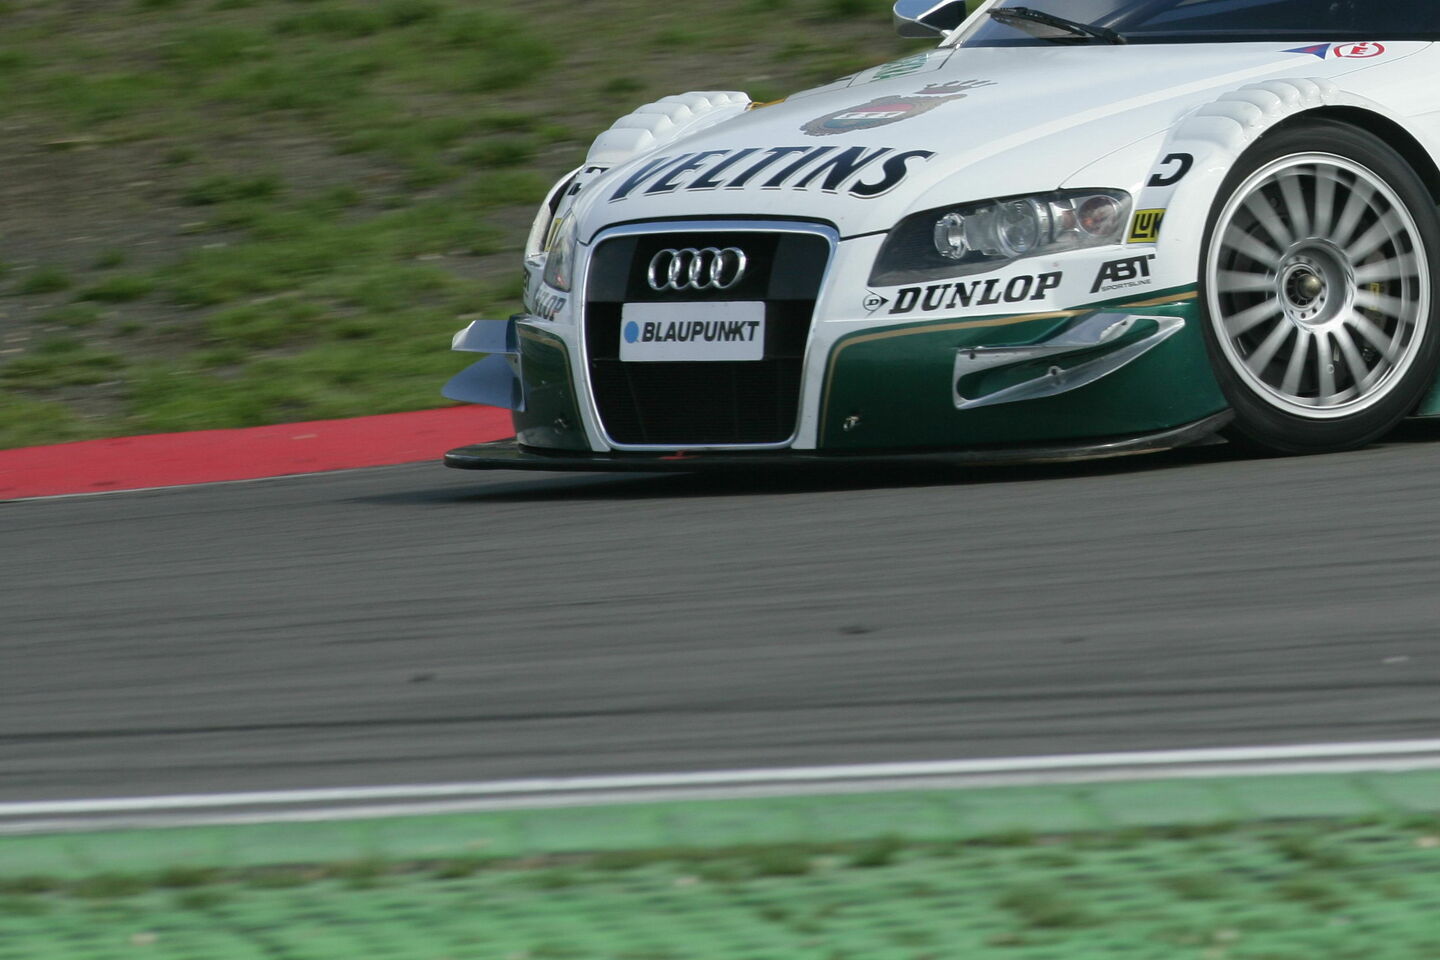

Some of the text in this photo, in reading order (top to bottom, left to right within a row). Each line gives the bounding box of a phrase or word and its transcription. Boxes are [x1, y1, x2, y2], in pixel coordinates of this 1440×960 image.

[607, 145, 937, 204] VELTINS
[888, 270, 1063, 315] DUNLOP
[1090, 253, 1156, 293] ABT
[641, 321, 760, 343] BLAUPUNKT
